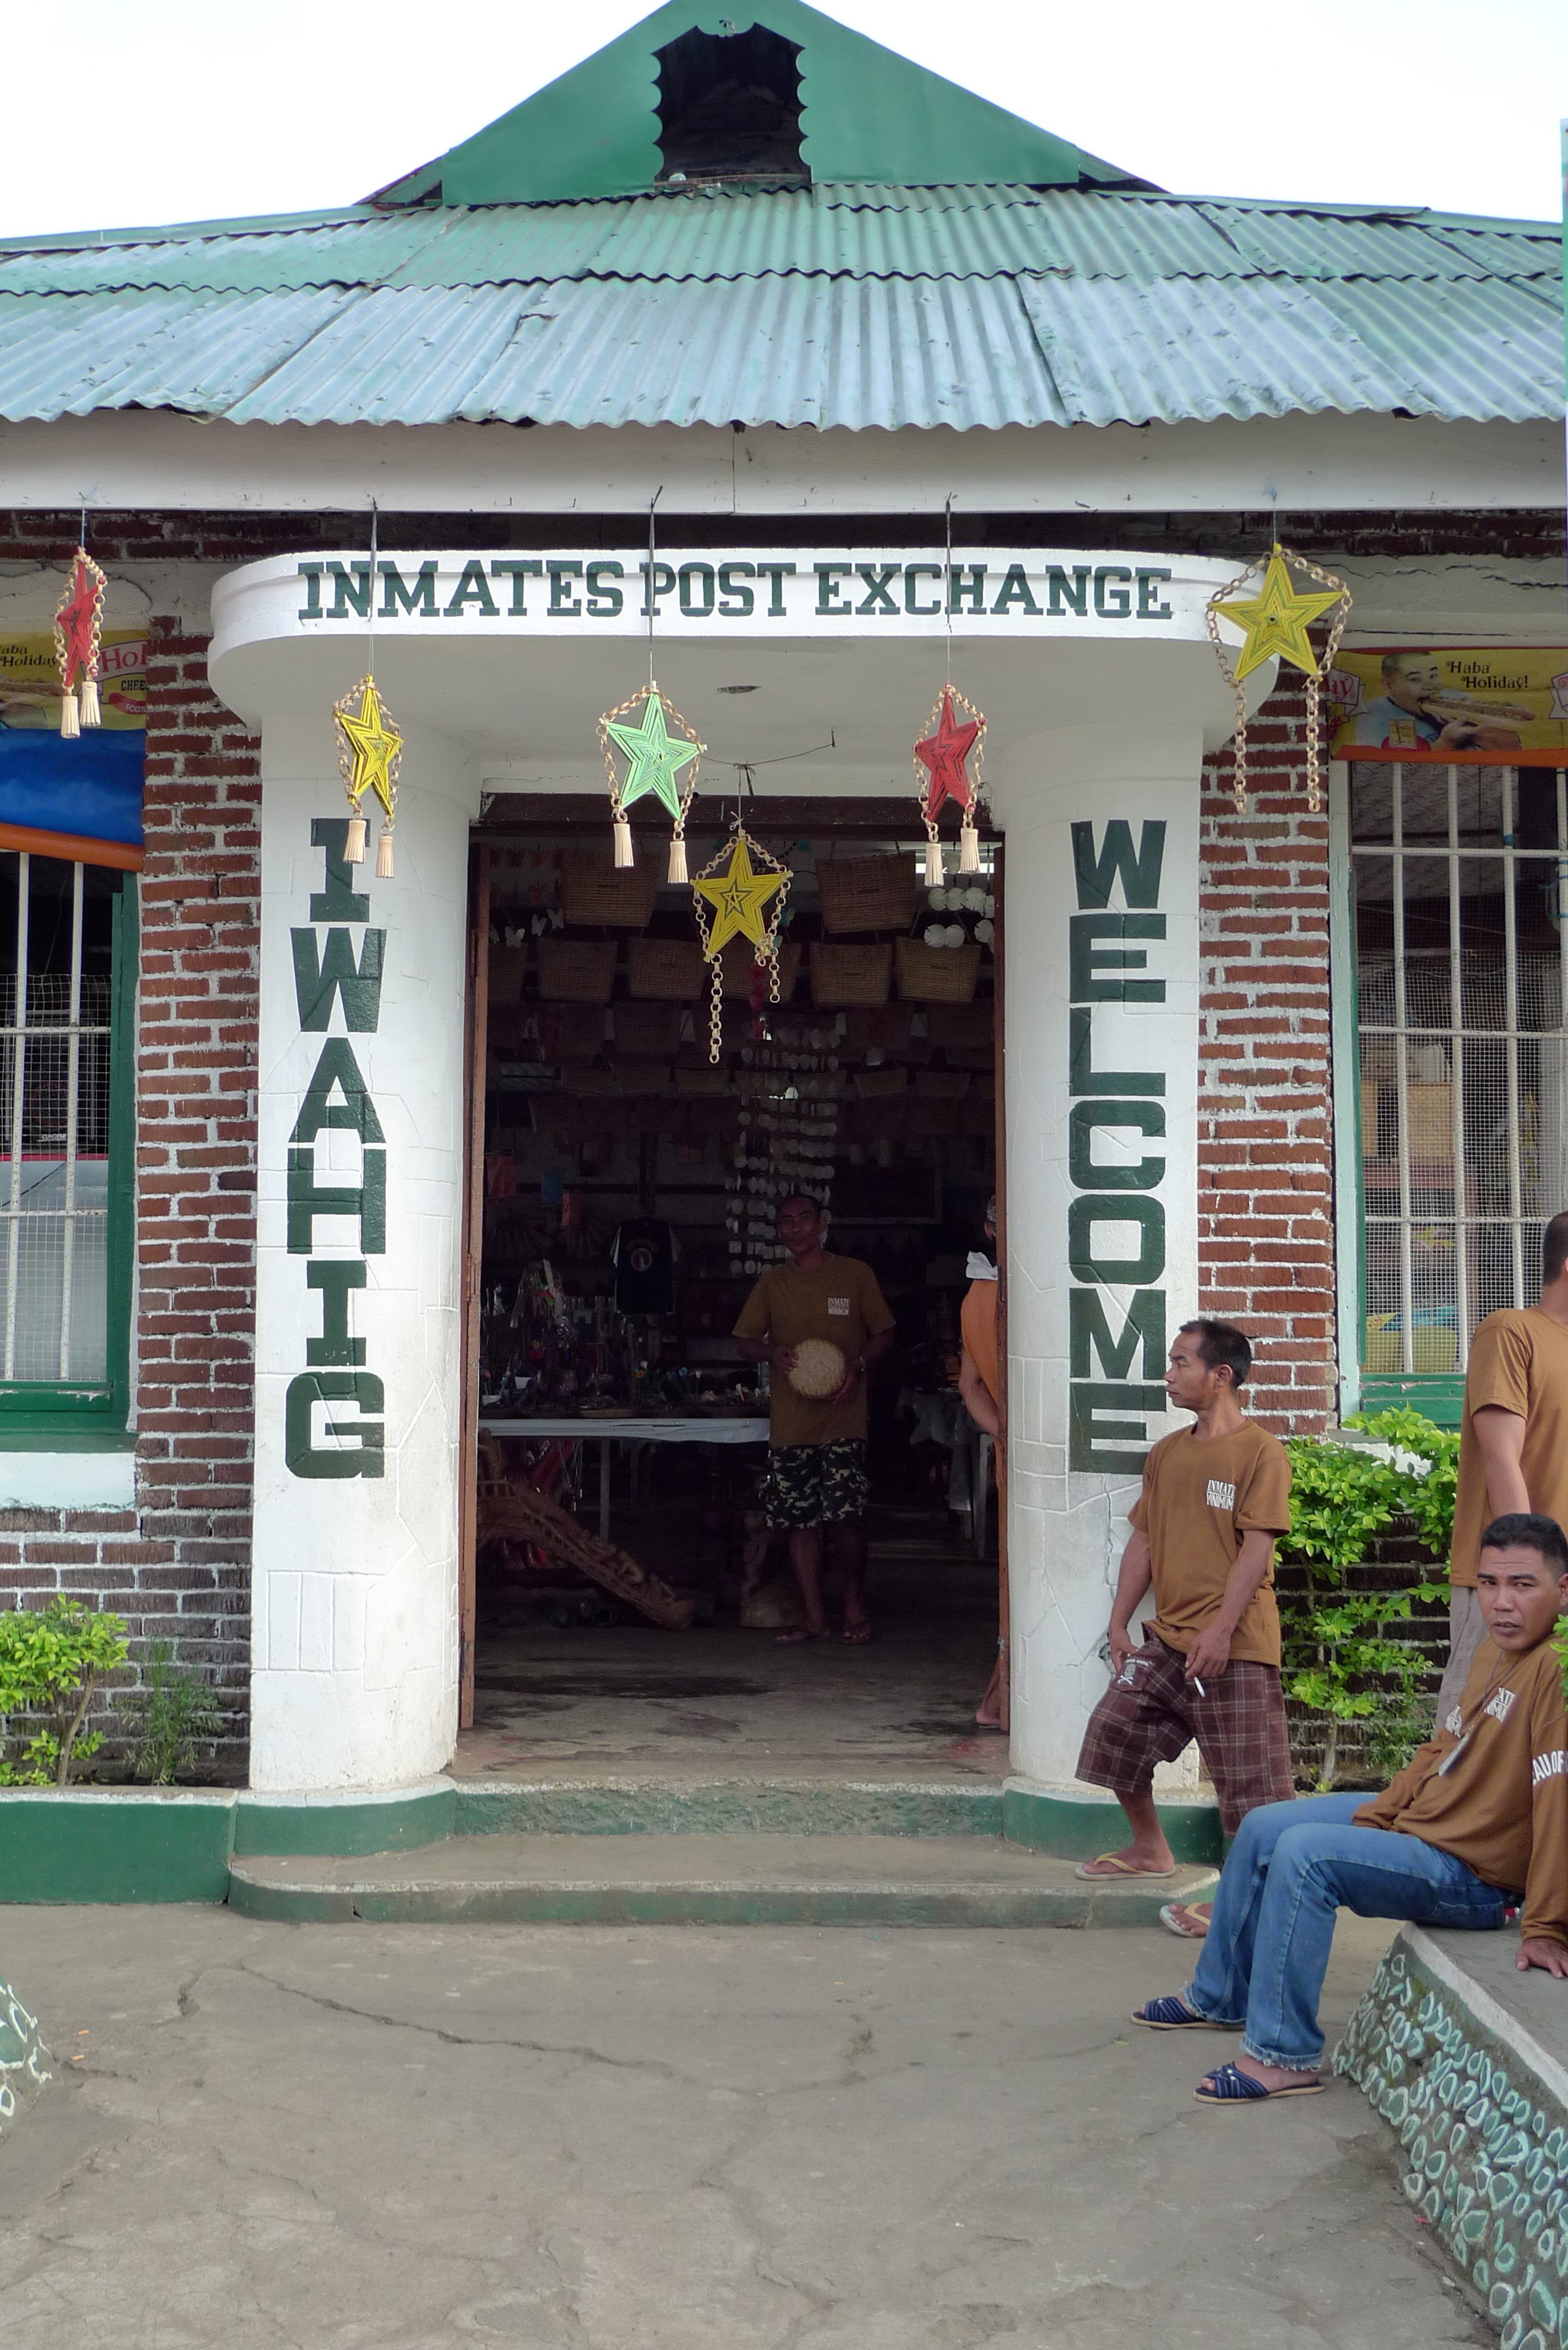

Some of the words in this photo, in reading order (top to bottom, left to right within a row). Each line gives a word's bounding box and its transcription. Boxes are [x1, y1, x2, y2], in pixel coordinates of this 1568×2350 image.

[298, 559, 623, 619] INMATES
[640, 562, 796, 617] POST
[813, 562, 1172, 619] EXCHANGE
[1445, 661, 1490, 673] Haba
[121, 680, 149, 691] CHEE
[1461, 675, 1528, 690] Holiday!
[284, 818, 388, 1479] IWAHIG
[1068, 819, 1167, 1474] WELCOME
[828, 1298, 850, 1306] INMATE
[1208, 1479, 1236, 1496] INMATE
[1206, 1493, 1234, 1511] MINIMUM
